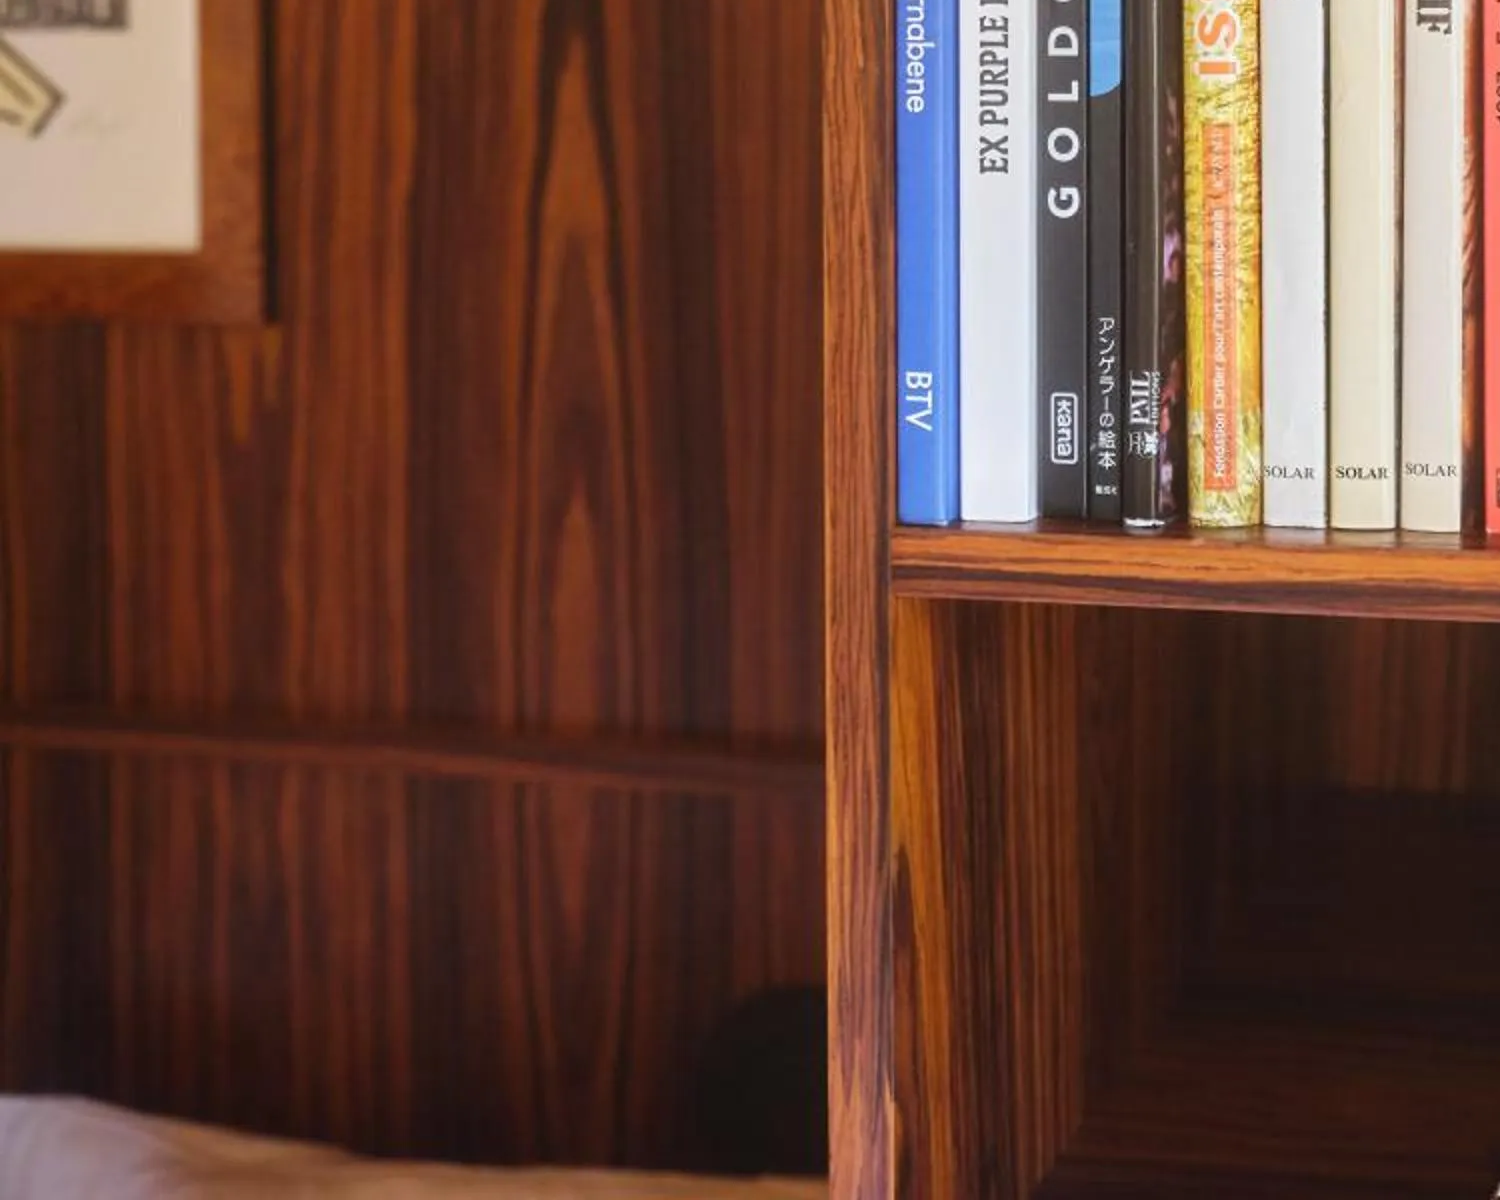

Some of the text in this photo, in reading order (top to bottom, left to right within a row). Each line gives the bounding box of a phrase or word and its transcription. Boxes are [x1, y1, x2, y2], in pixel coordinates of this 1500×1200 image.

[979, 16, 1009, 126] PURPLE
[979, 136, 1009, 174] EX
[1212, 209, 1226, 302] contemporain
[1212, 331, 1226, 363] pour
[906, 371, 932, 431] BTV
[1212, 365, 1226, 409] Cartier
[1056, 400, 1073, 457] kana
[1212, 413, 1226, 478] Fondation
[1264, 465, 1316, 481] SOLAR
[1335, 466, 1389, 481] SOLAR
[1405, 463, 1458, 478] SOLAR
